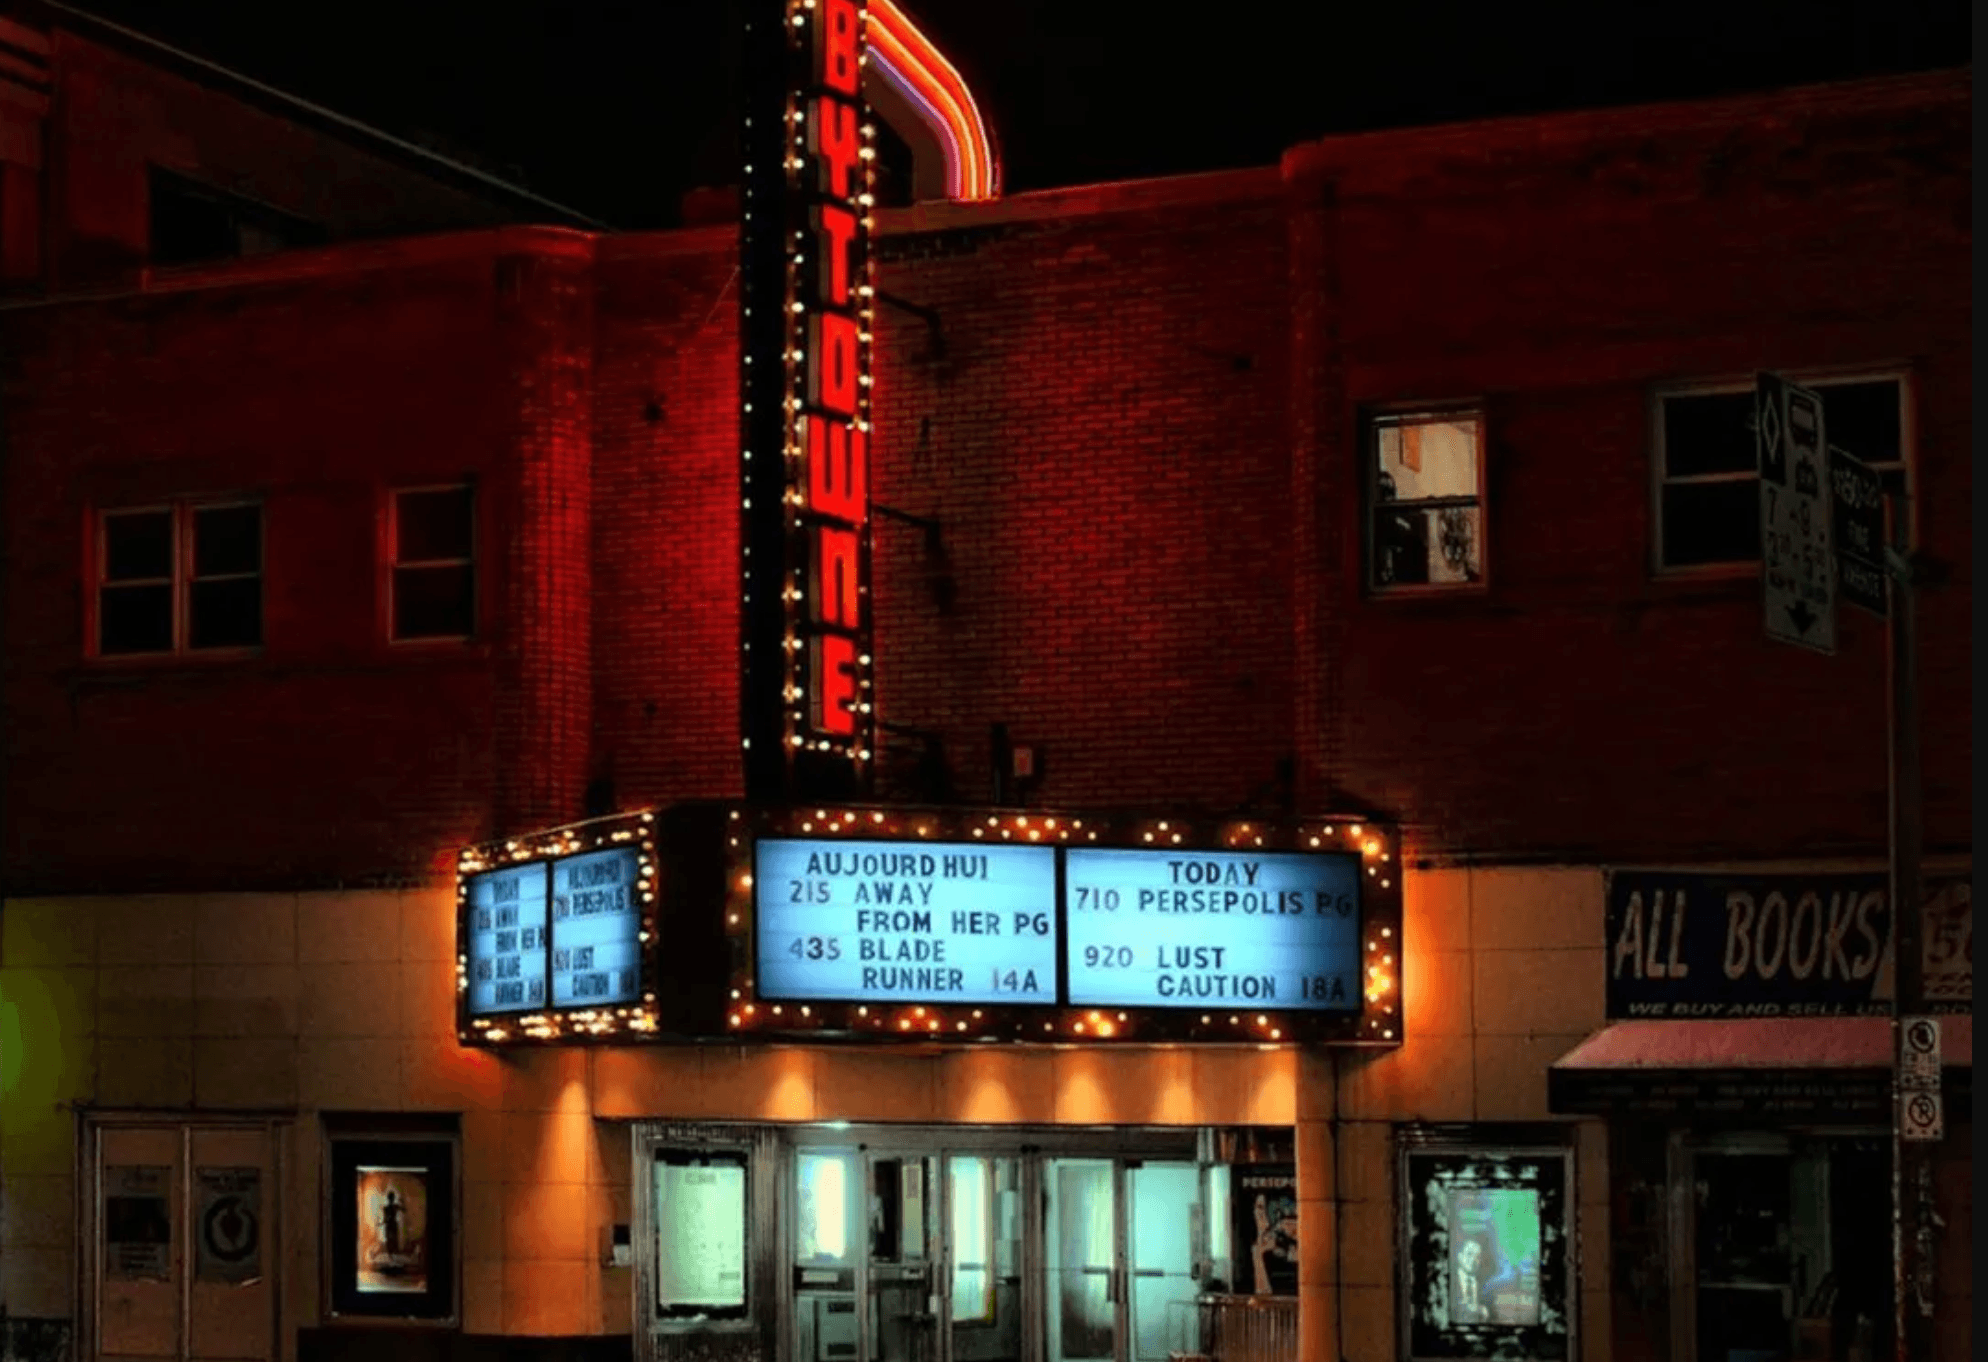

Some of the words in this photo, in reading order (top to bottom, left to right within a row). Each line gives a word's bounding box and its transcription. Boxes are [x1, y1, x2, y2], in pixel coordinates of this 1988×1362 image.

[810, 0, 867, 735] BYTOWNE
[1168, 861, 1260, 886] TODAY
[789, 880, 830, 904] 215
[854, 882, 934, 905] AWAY
[1075, 887, 1120, 912] 710
[1138, 888, 1304, 915] PERSEPOLIS
[1316, 891, 1354, 918] PG
[857, 909, 932, 934] FROM
[951, 911, 1000, 935] HER
[1013, 912, 1050, 936] PG
[1613, 888, 1690, 981] ALL
[1722, 889, 1885, 984] BOOKS
[788, 937, 841, 961] 435
[859, 938, 946, 962] BLADE
[1084, 945, 1133, 968] 920
[1157, 946, 1226, 969] LUST
[862, 966, 964, 991] RUNNER
[992, 969, 1039, 993] 14A
[1157, 974, 1276, 999] CAUTION
[1302, 977, 1345, 1000] 18A
[1627, 1001, 1668, 1016] WE
[1671, 1001, 1725, 1016] BUY
[1726, 1001, 1781, 1016] AND
[1787, 1001, 1849, 1016] SELL
